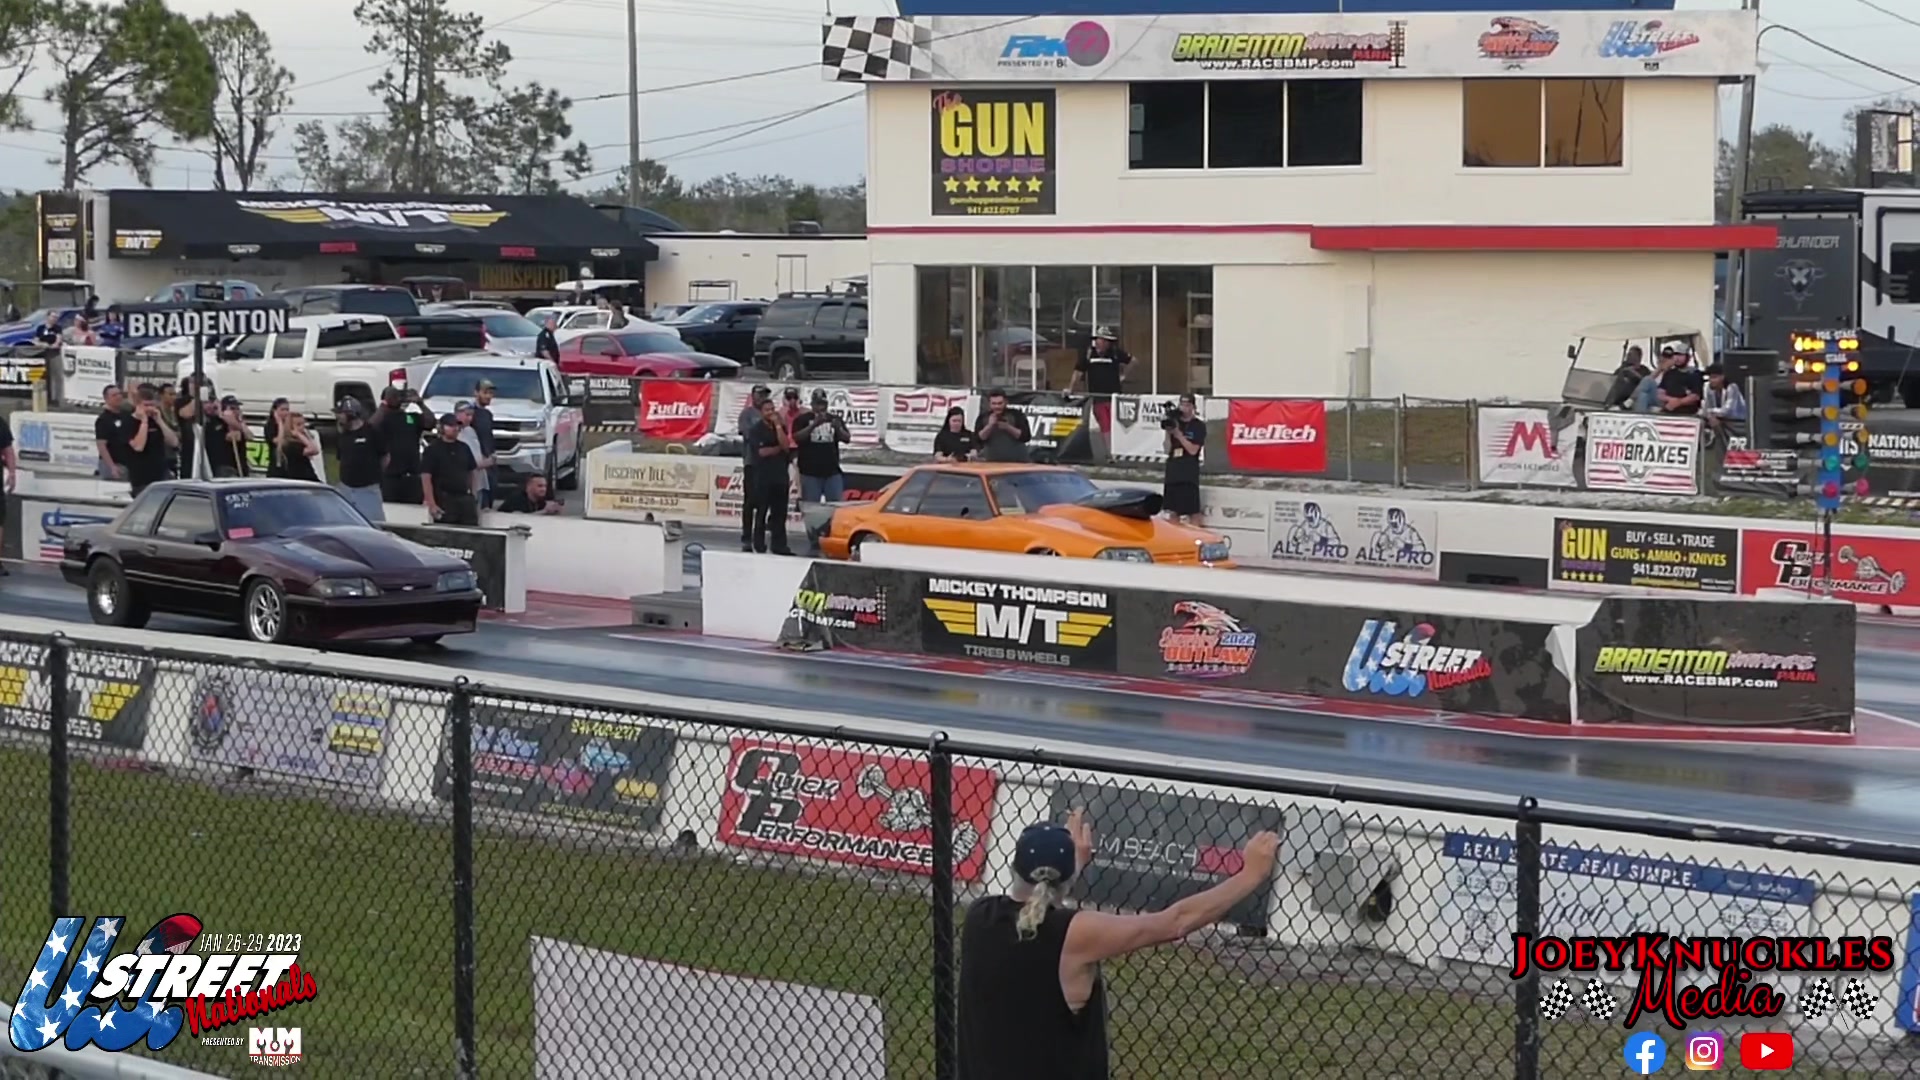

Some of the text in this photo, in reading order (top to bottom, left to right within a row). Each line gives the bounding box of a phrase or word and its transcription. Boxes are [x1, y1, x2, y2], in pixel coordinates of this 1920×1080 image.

[1172, 33, 1306, 60] BRADENTON
[1201, 58, 1355, 69] www.RACEBMP.com
[940, 102, 1045, 156] GUN
[940, 157, 1046, 173] SHOPPE
[341, 202, 493, 212] THOMPSON
[128, 309, 286, 338] BRADENTON
[646, 400, 705, 420] FuelTech
[1232, 423, 1316, 445] FuelTech
[1273, 541, 1349, 559] ALL-PRO
[1561, 527, 1607, 561] GUN
[1626, 531, 1715, 548] BUY SELL TRADE
[1355, 547, 1434, 566] ALL-PRO
[1610, 547, 1727, 566] GUNS AMMO KNIVES
[929, 578, 1107, 608] MICKEY THOMPSON
[975, 602, 1068, 644] M/T
[1220, 632, 1257, 647] 2022
[964, 644, 1003, 658] TIRES
[1017, 649, 1070, 667] WHEELS
[1380, 642, 1483, 674] STREET
[1594, 647, 1728, 675] BRADENTON
[1621, 674, 1779, 689] www.RACEBMP.com
[1579, 857, 1622, 878] REAL
